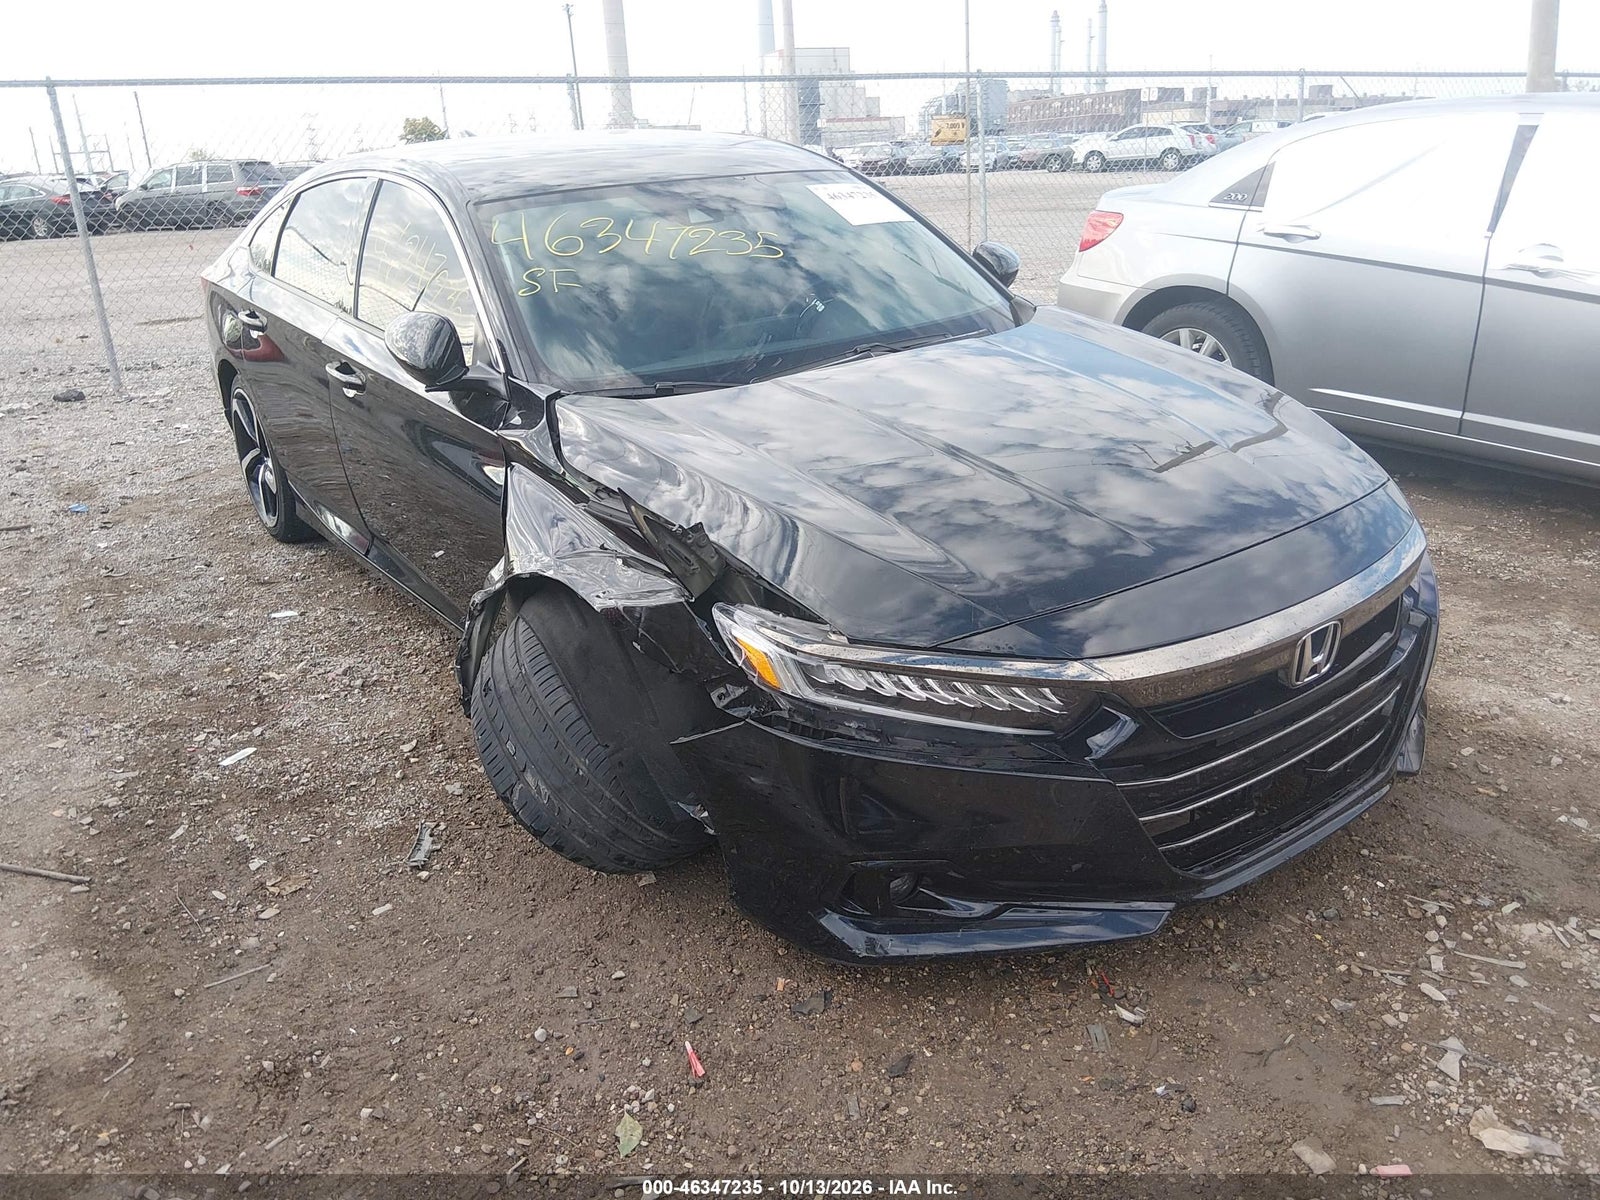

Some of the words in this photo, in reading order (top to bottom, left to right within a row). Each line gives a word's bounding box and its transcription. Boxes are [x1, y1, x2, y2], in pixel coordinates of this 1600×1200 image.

[1223, 193, 1248, 201] 200
[491, 211, 784, 261] 46347235
[518, 267, 583, 297] SF
